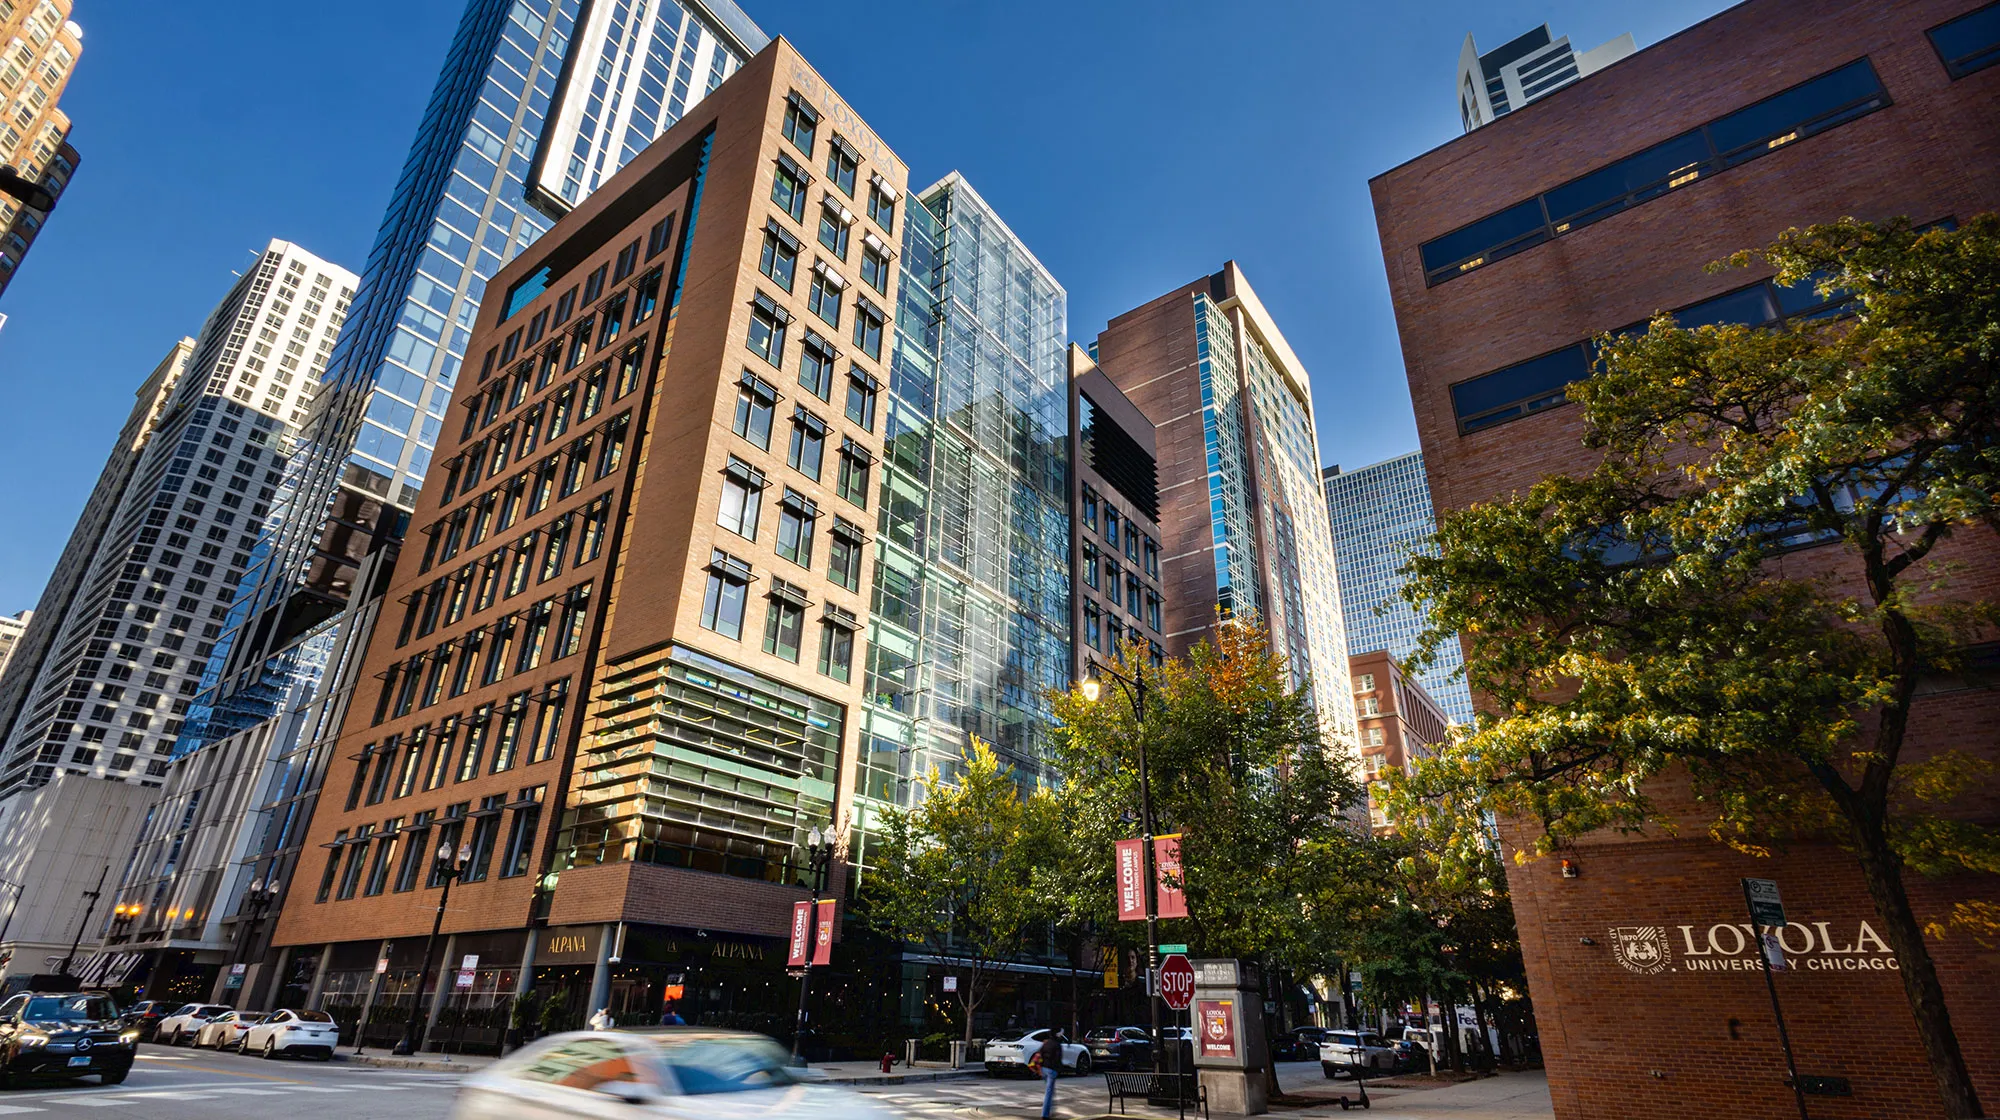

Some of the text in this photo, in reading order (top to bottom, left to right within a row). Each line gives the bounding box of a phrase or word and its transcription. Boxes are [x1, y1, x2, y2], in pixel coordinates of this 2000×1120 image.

[1122, 848, 1135, 913] WELCOME
[792, 908, 805, 959] WELCOME
[548, 936, 586, 953] ALPANA
[711, 941, 764, 961] ALPANA
[1686, 958, 1797, 971] UNIVERSY
[1163, 972, 1193, 992] STOP
[1206, 1043, 1231, 1051] WELCOME
